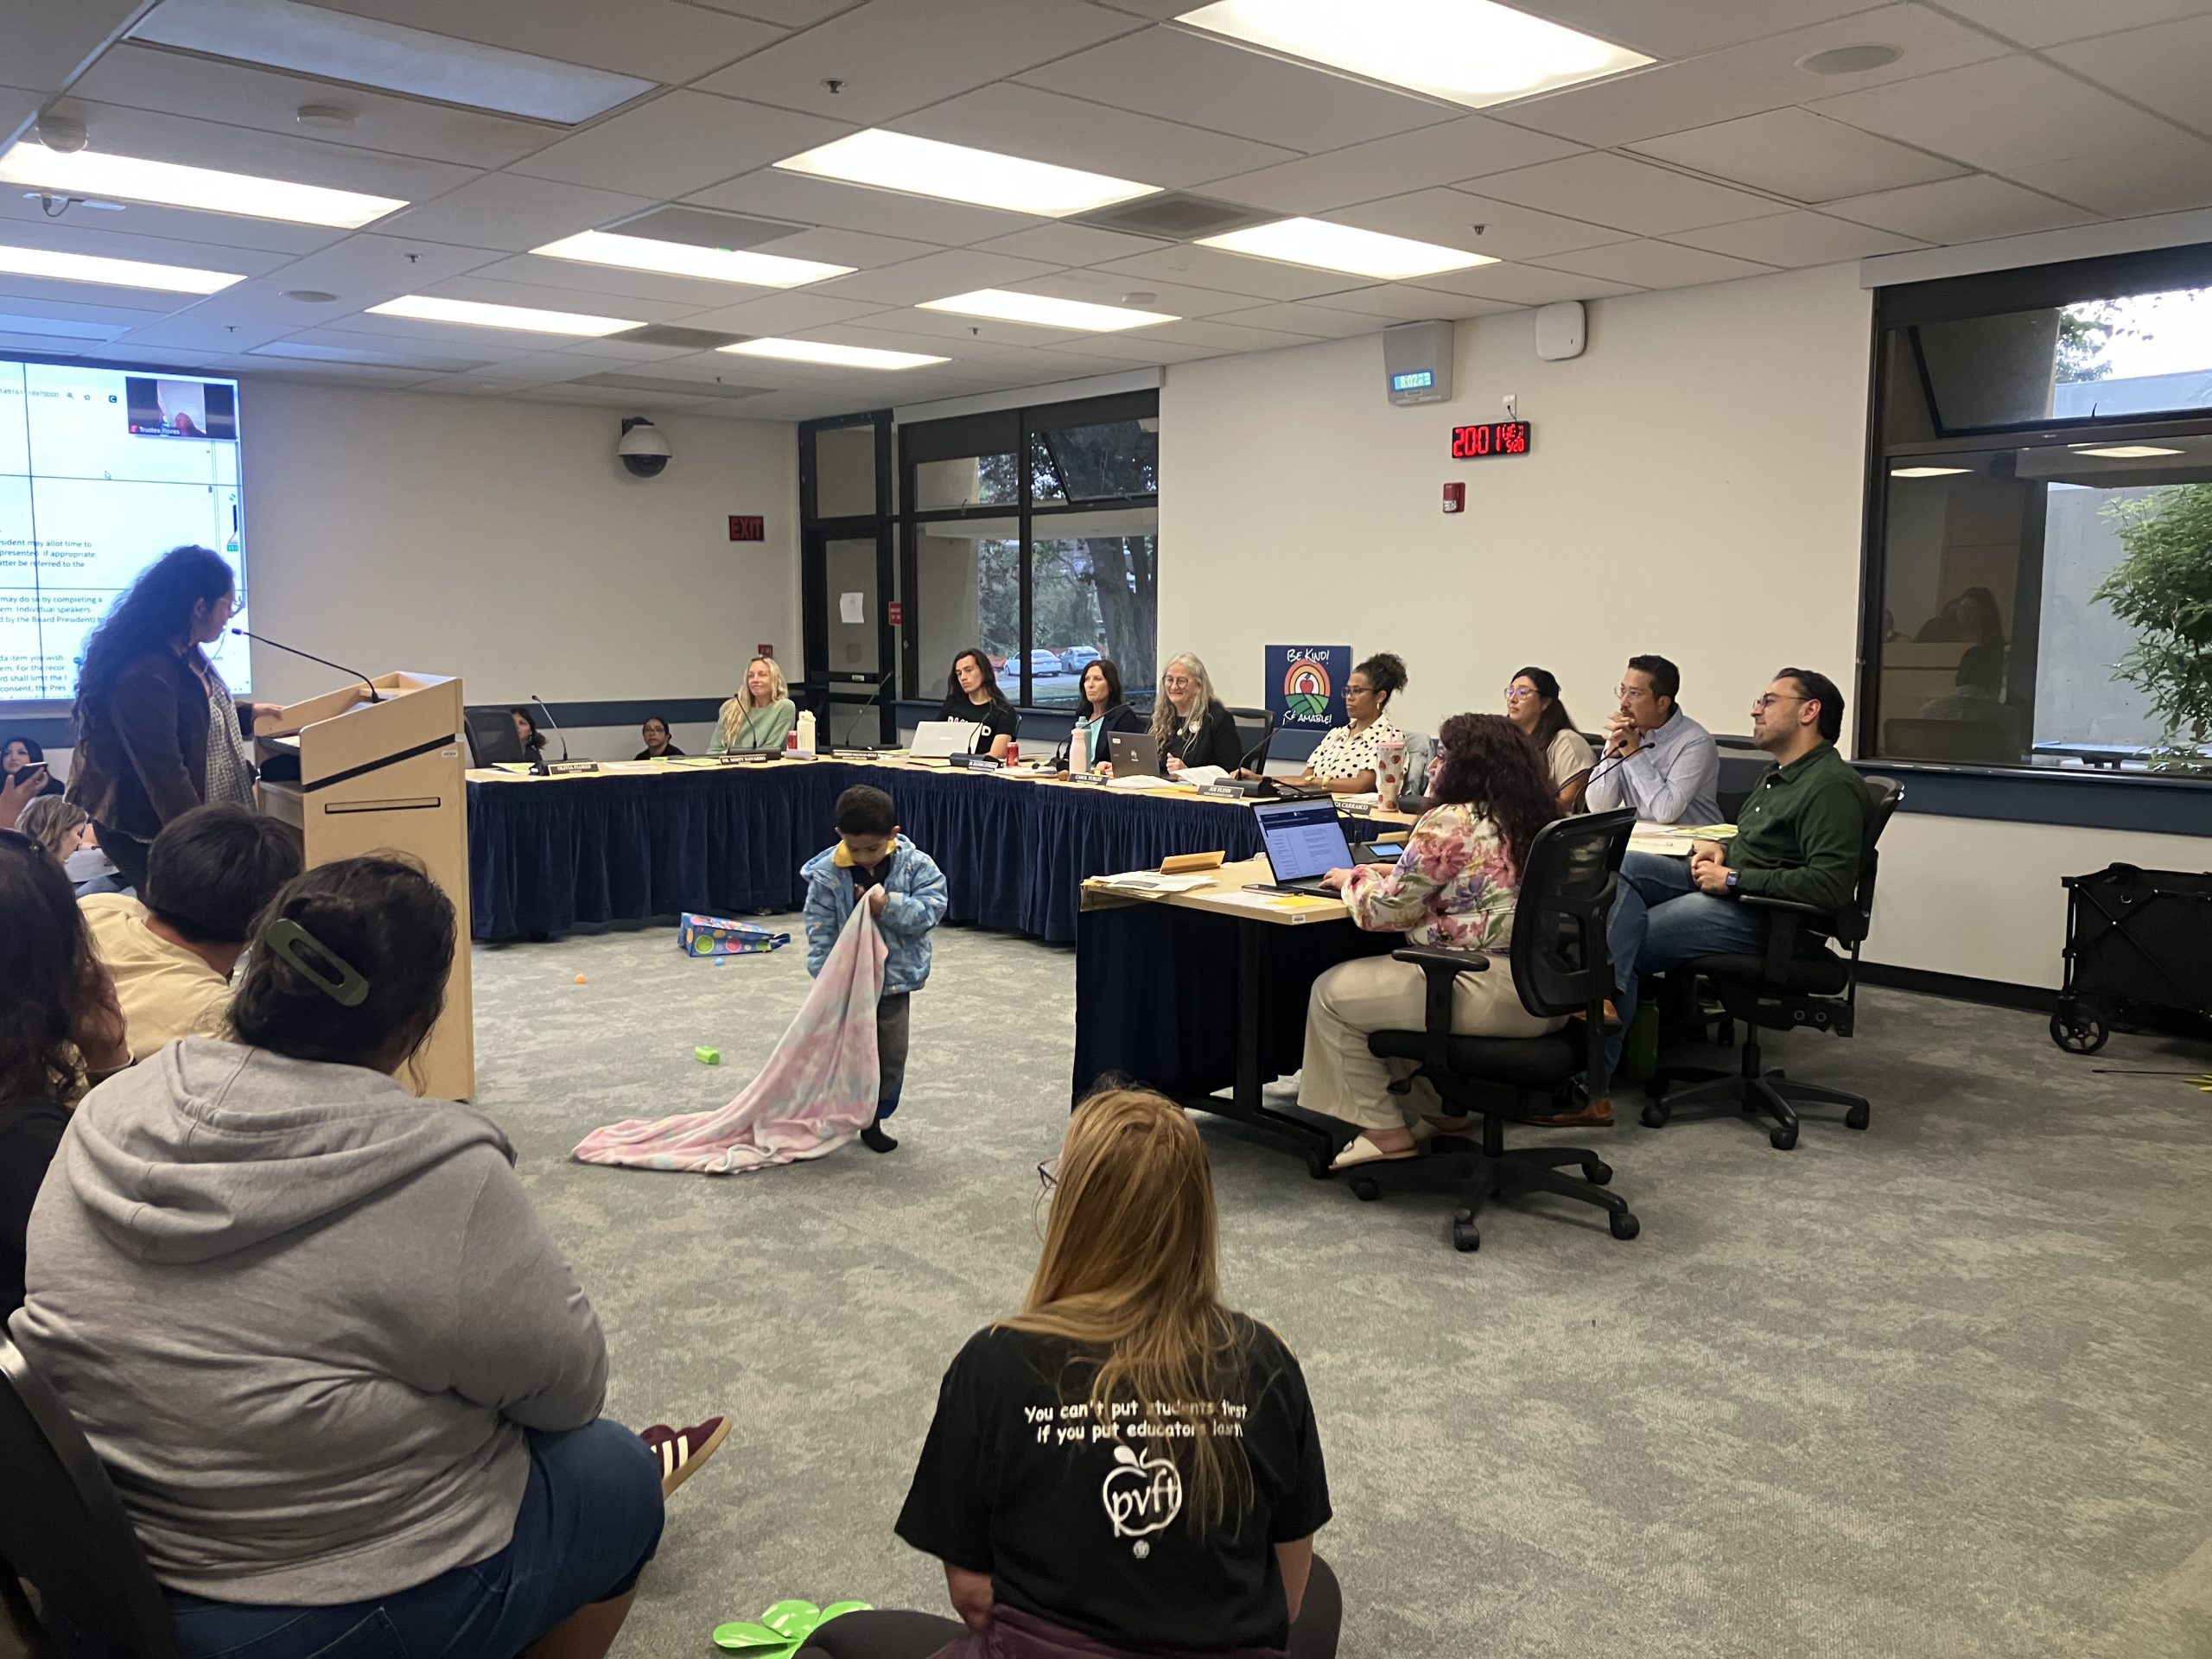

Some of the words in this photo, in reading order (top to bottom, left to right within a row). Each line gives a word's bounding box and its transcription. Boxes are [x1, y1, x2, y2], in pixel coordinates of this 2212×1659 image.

[730, 518, 761, 540] EXIT
[53, 596, 97, 605] completing
[1024, 1405, 1054, 1424] You
[1060, 1400, 1103, 1420] can't
[1111, 1399, 1139, 1421] put
[1037, 1424, 1051, 1444] if
[1056, 1425, 1085, 1446] you
[1092, 1421, 1120, 1444] put
